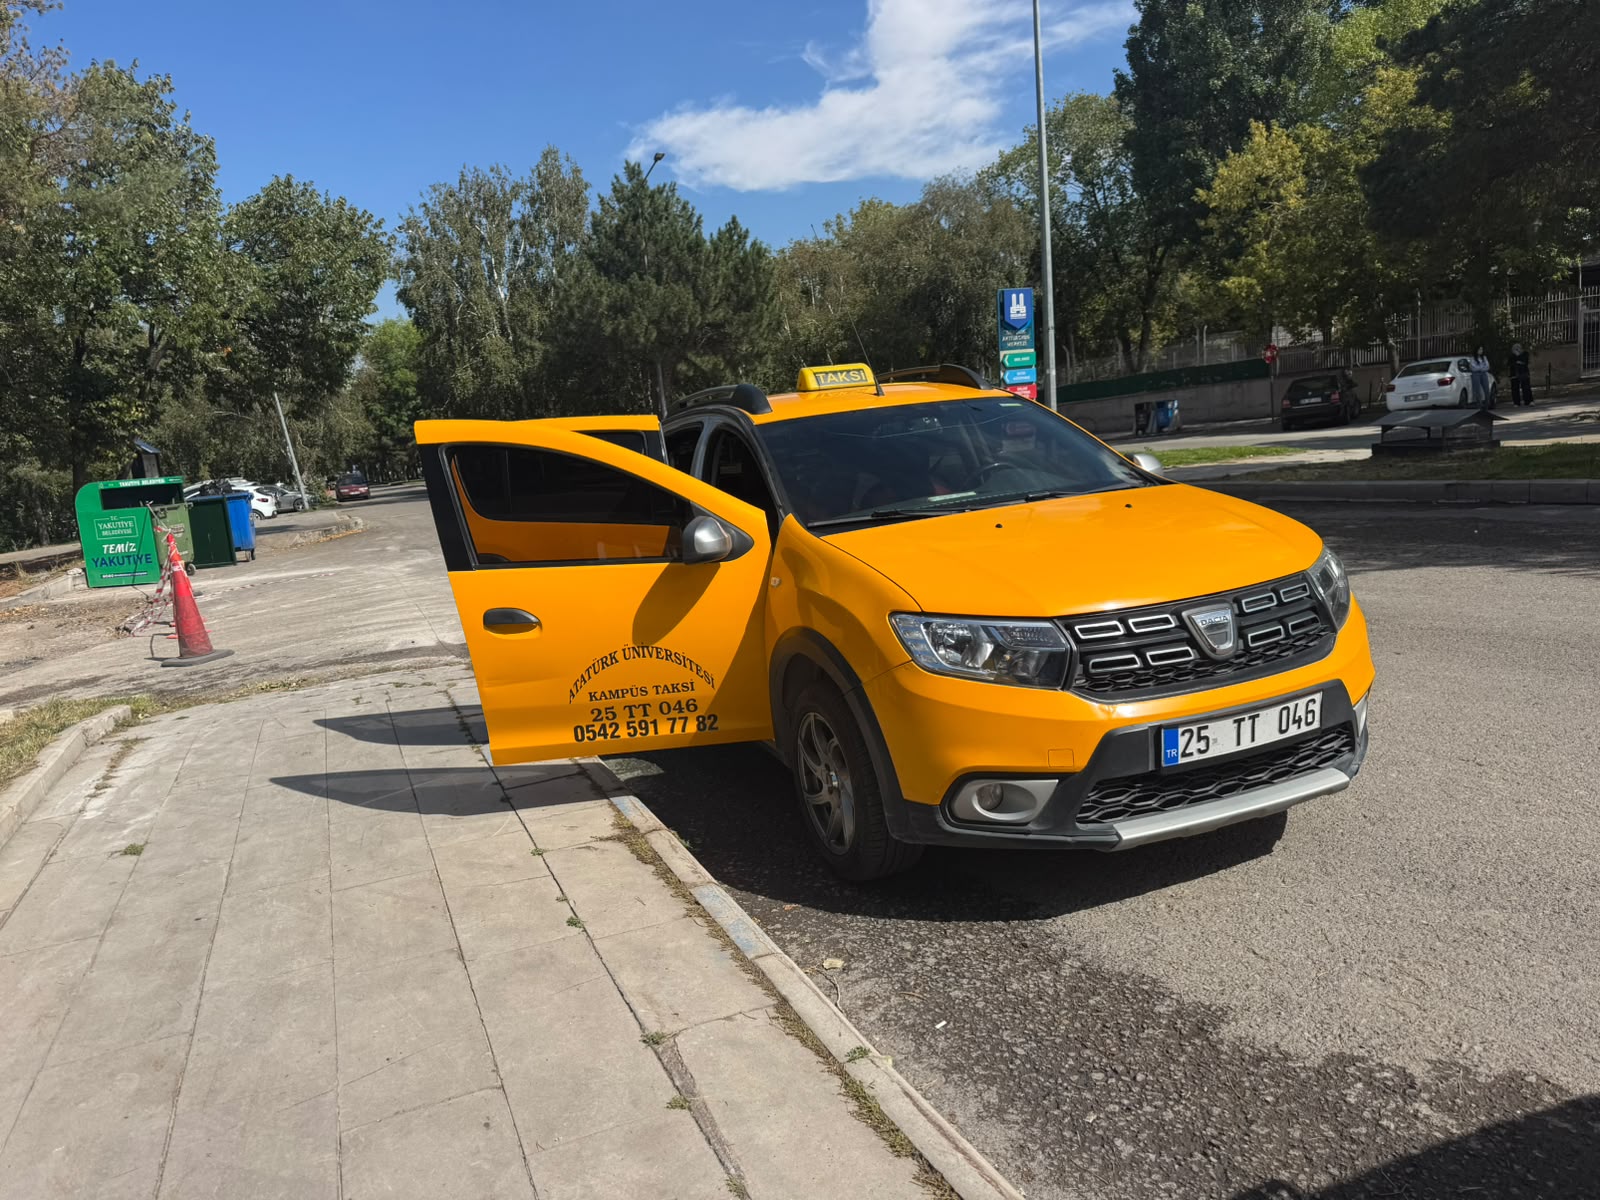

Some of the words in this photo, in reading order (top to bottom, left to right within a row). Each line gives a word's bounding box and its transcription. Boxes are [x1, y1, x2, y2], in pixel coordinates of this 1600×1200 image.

[98, 521, 134, 530] YAKUTİYE
[102, 541, 137, 554] TEMİZ
[92, 554, 153, 568] YAKUTİYE
[1200, 615, 1229, 627] DACIA
[569, 650, 620, 704] ATATÜRK
[621, 642, 716, 691] ÜNİVERSİTESİ
[588, 684, 649, 702] KAMPÜS
[652, 679, 695, 696] TAKSİ
[590, 706, 618, 722] 25
[623, 703, 652, 719] TT
[658, 698, 699, 715] 046
[573, 722, 621, 742] 0542
[626, 718, 659, 738] 591
[667, 716, 689, 734] 77
[695, 713, 719, 732] 82
[1180, 725, 1210, 758] 25
[1233, 713, 1260, 747] TT
[1278, 698, 1316, 735] 046
[1166, 748, 1178, 758] TR
